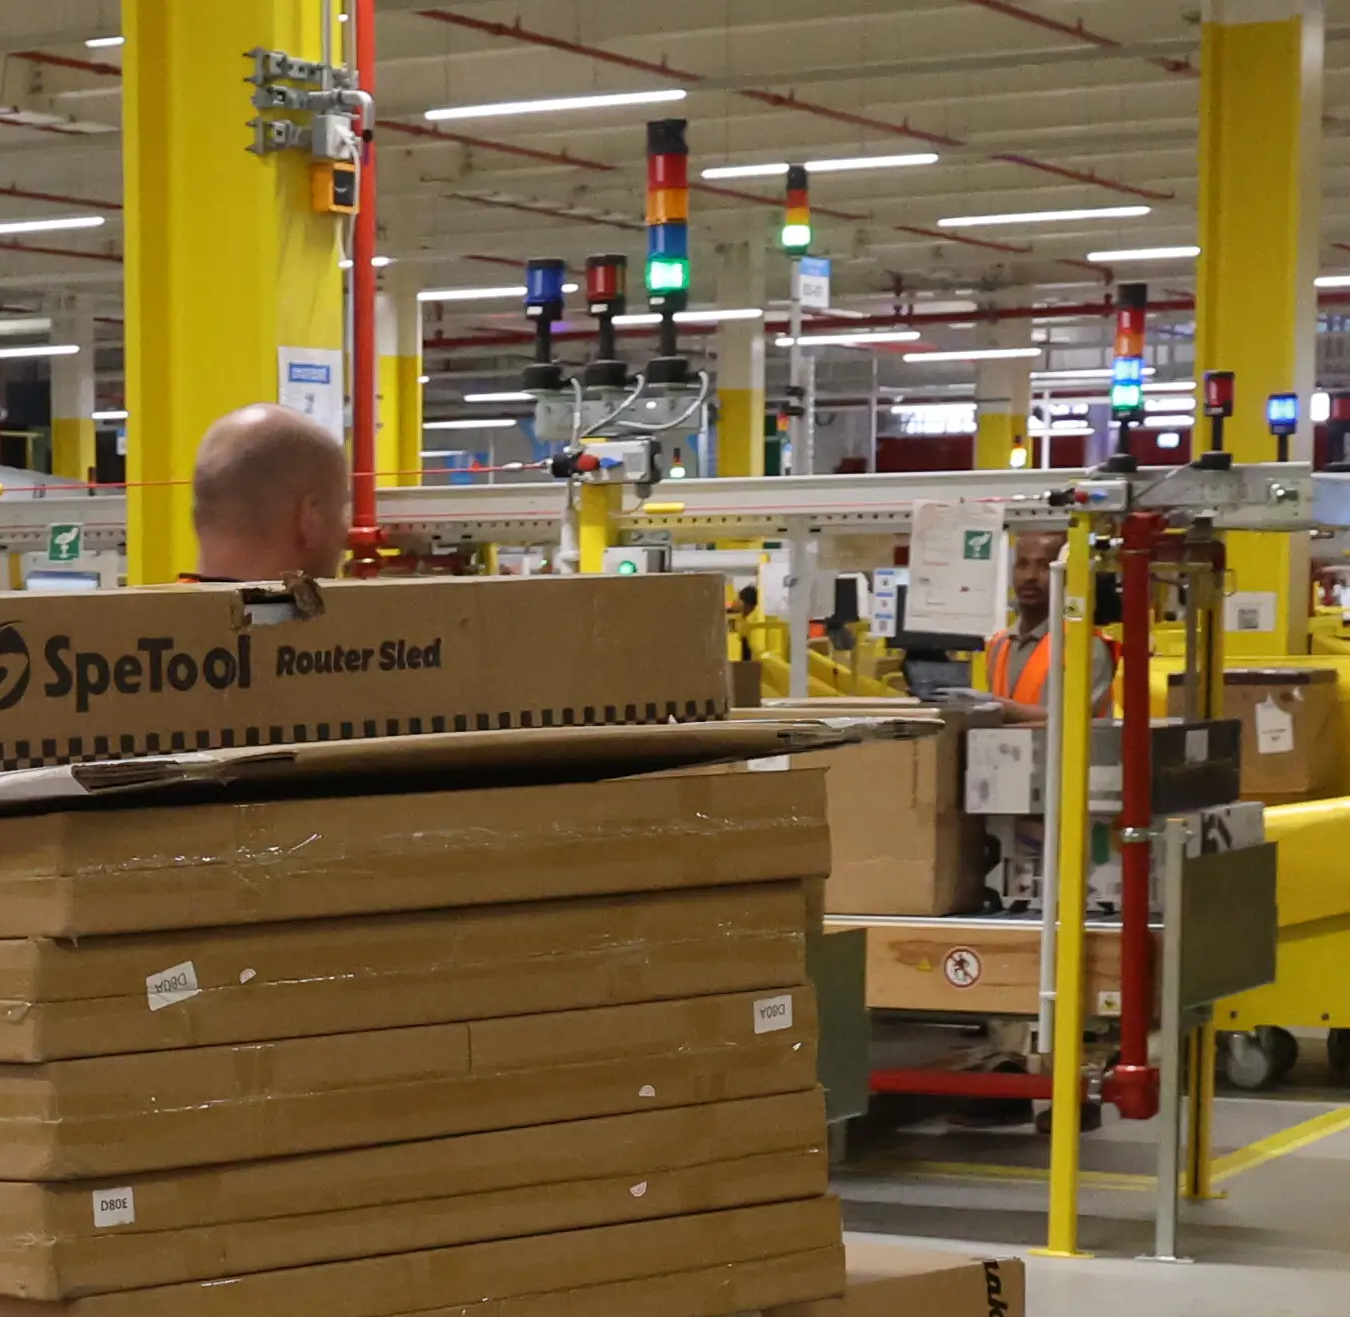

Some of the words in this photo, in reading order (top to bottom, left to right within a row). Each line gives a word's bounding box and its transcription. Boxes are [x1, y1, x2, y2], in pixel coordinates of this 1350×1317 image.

[43, 633, 252, 713] SpeTool
[276, 644, 374, 677] Router
[378, 637, 442, 671] Sled
[100, 1197, 128, 1212] D80E
